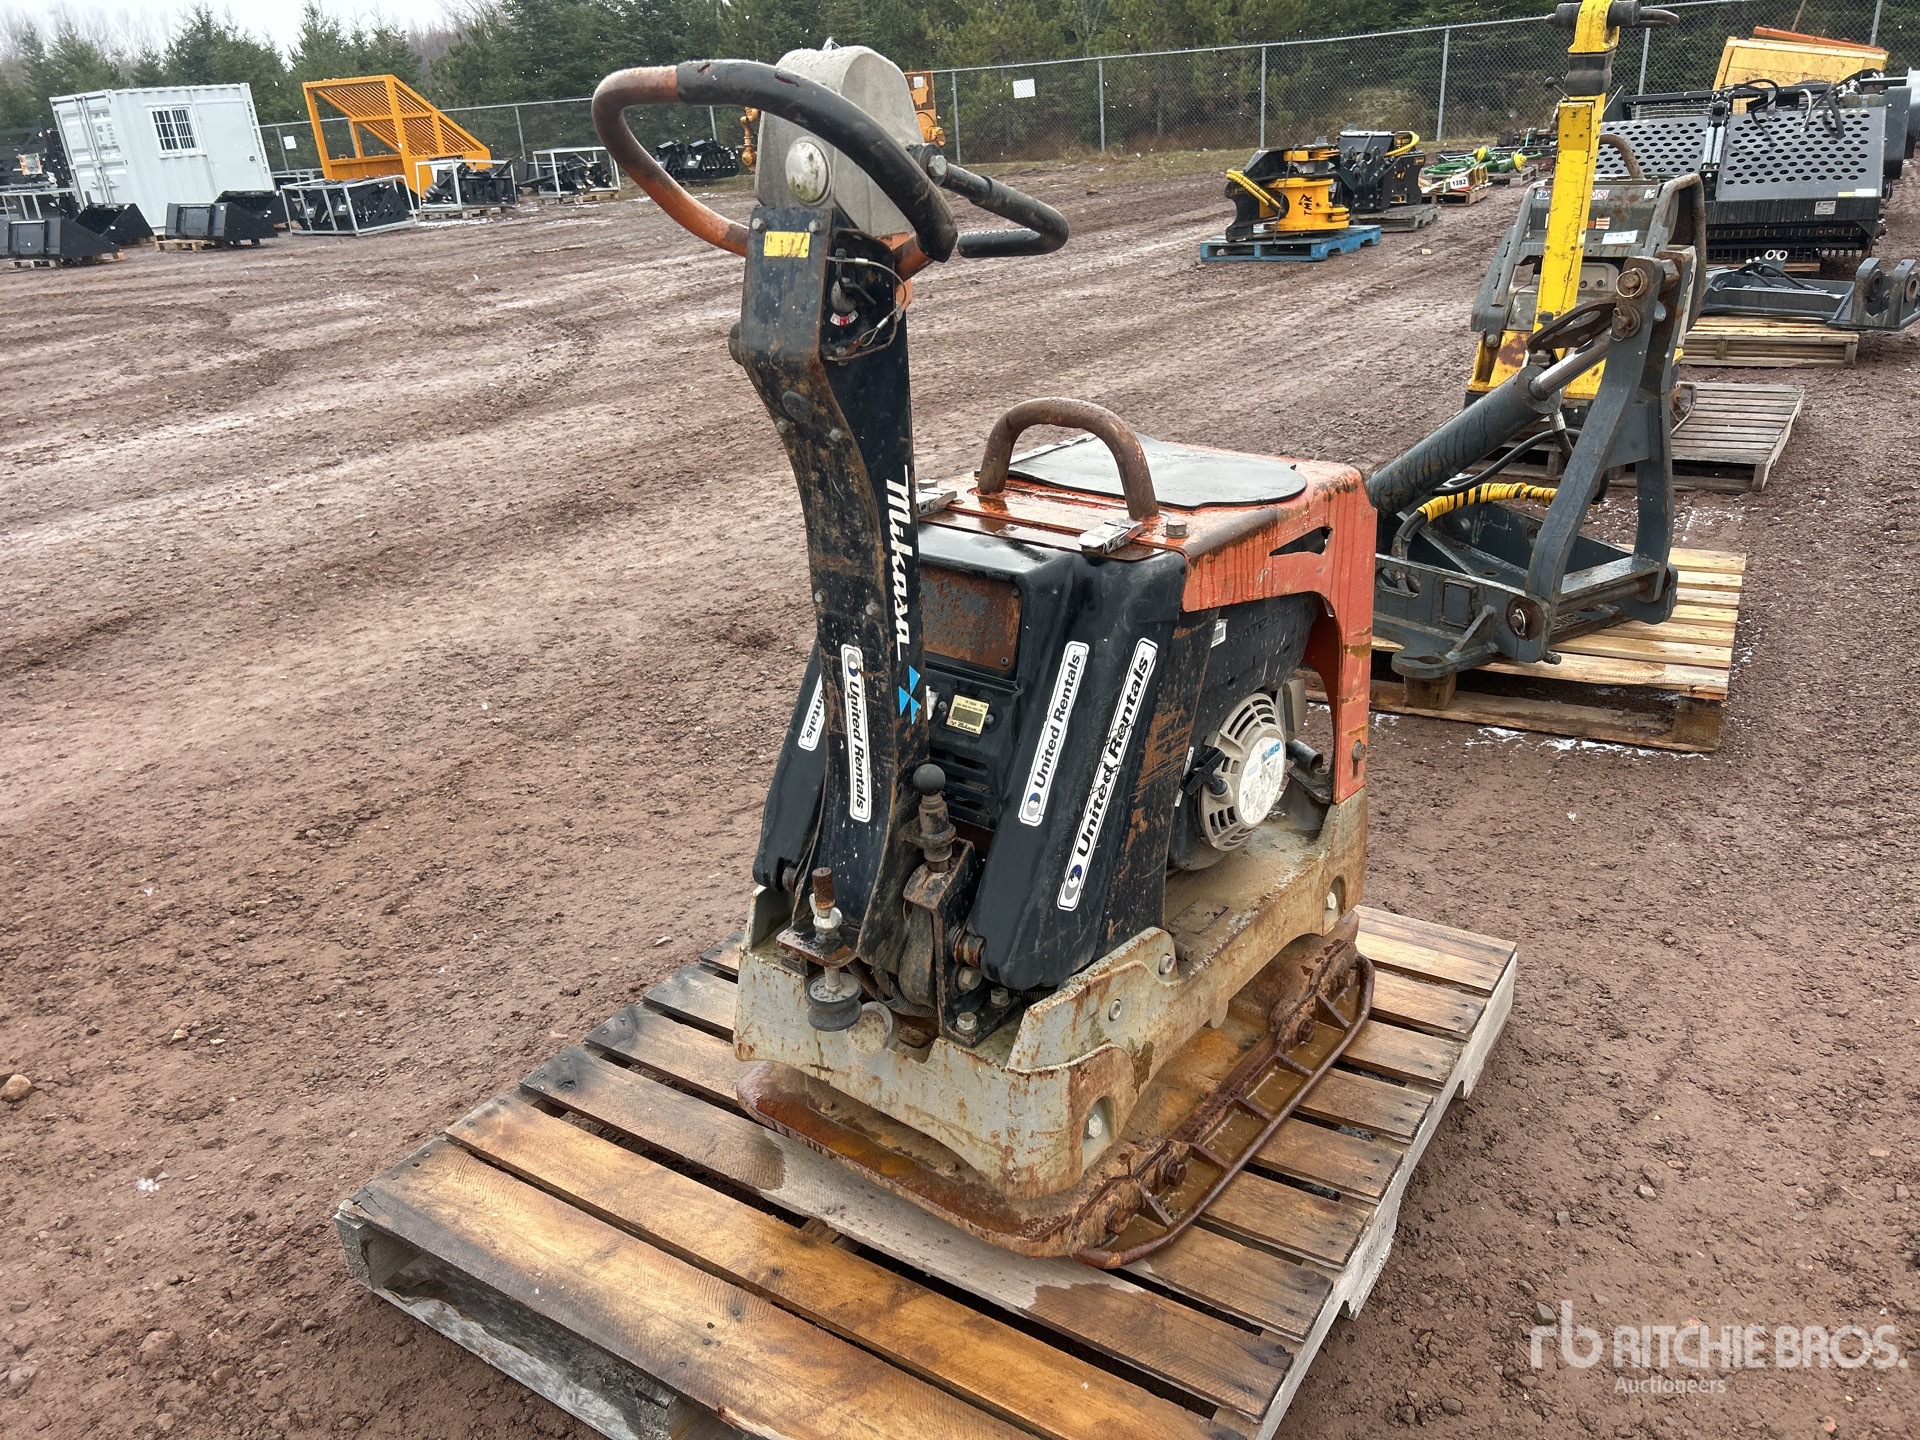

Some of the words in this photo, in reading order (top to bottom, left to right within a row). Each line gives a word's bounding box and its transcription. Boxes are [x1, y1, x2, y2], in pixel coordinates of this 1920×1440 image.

[886, 464, 913, 661] Mikasa
[805, 690, 824, 739] entals
[849, 681, 863, 742] United
[1034, 725, 1061, 789] United
[1053, 653, 1080, 723] Rentals
[1077, 764, 1118, 857] United
[1108, 657, 1148, 759] Rentals
[854, 744, 867, 812] Rentals
